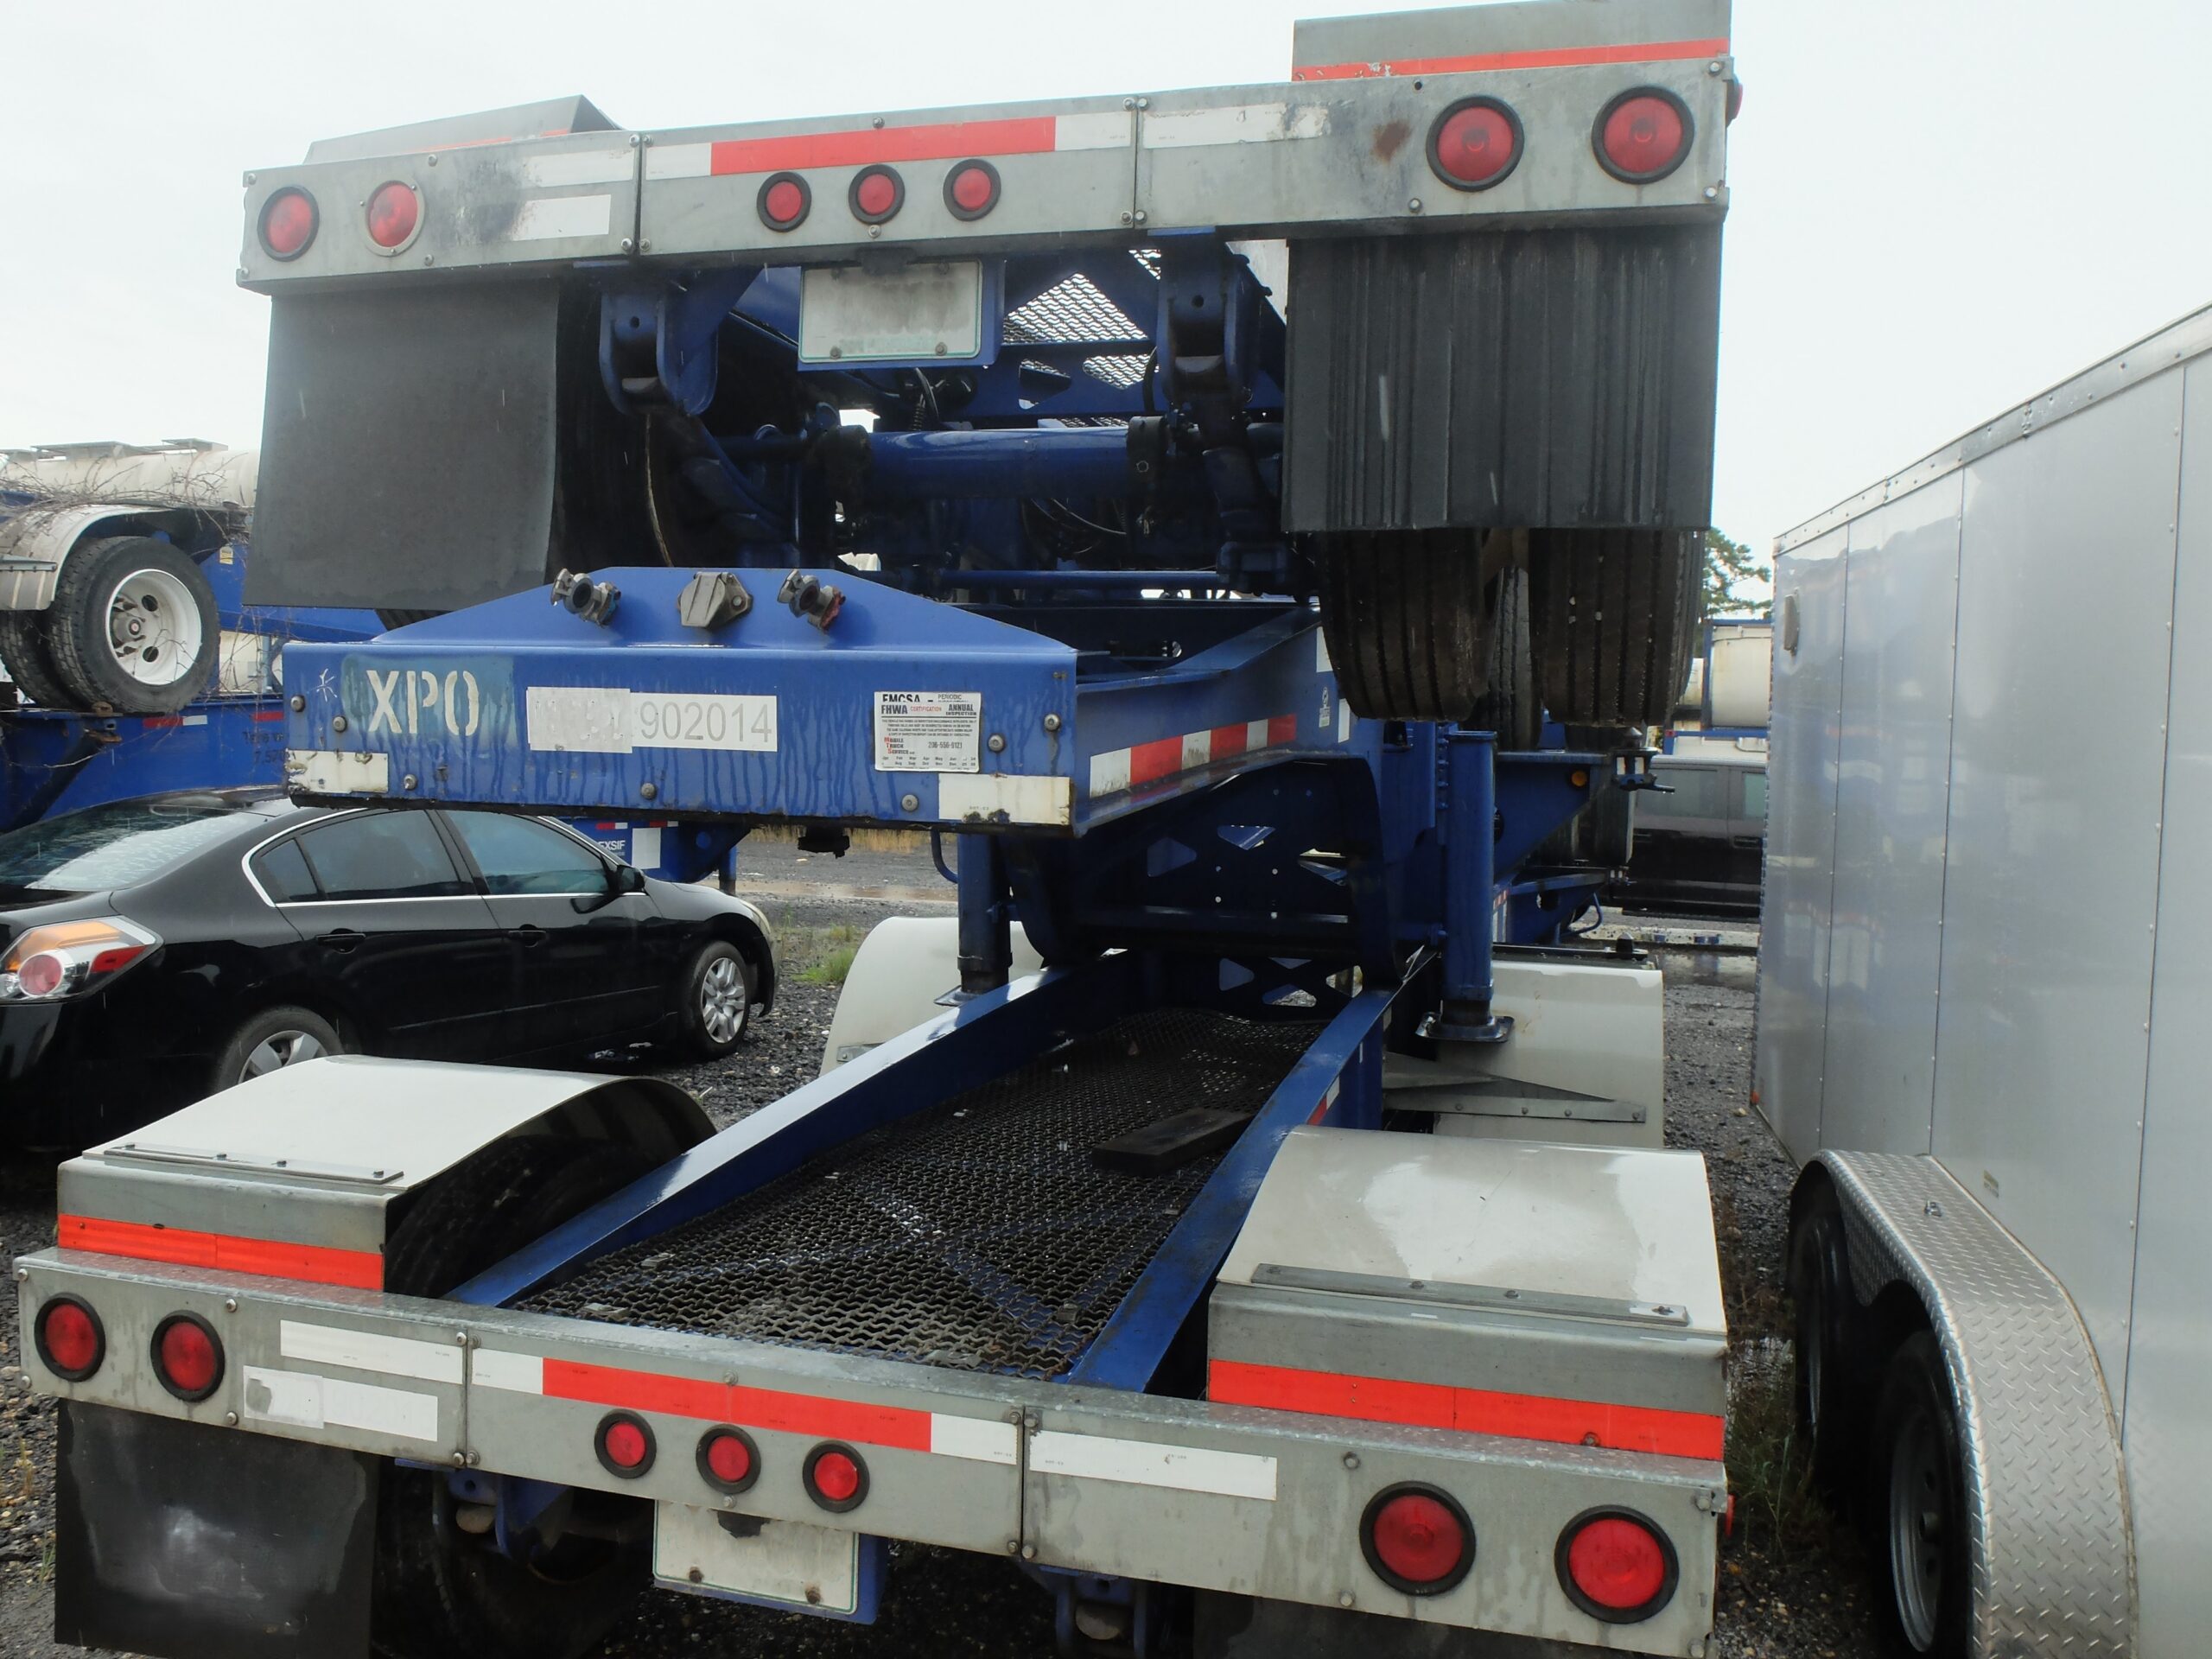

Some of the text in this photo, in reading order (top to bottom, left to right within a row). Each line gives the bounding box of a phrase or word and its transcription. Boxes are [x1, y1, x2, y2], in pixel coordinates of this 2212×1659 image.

[366, 670, 479, 736] XPO
[881, 704, 908, 715] FHWA
[948, 703, 974, 712] ANNUAL
[639, 701, 772, 742] 902014
